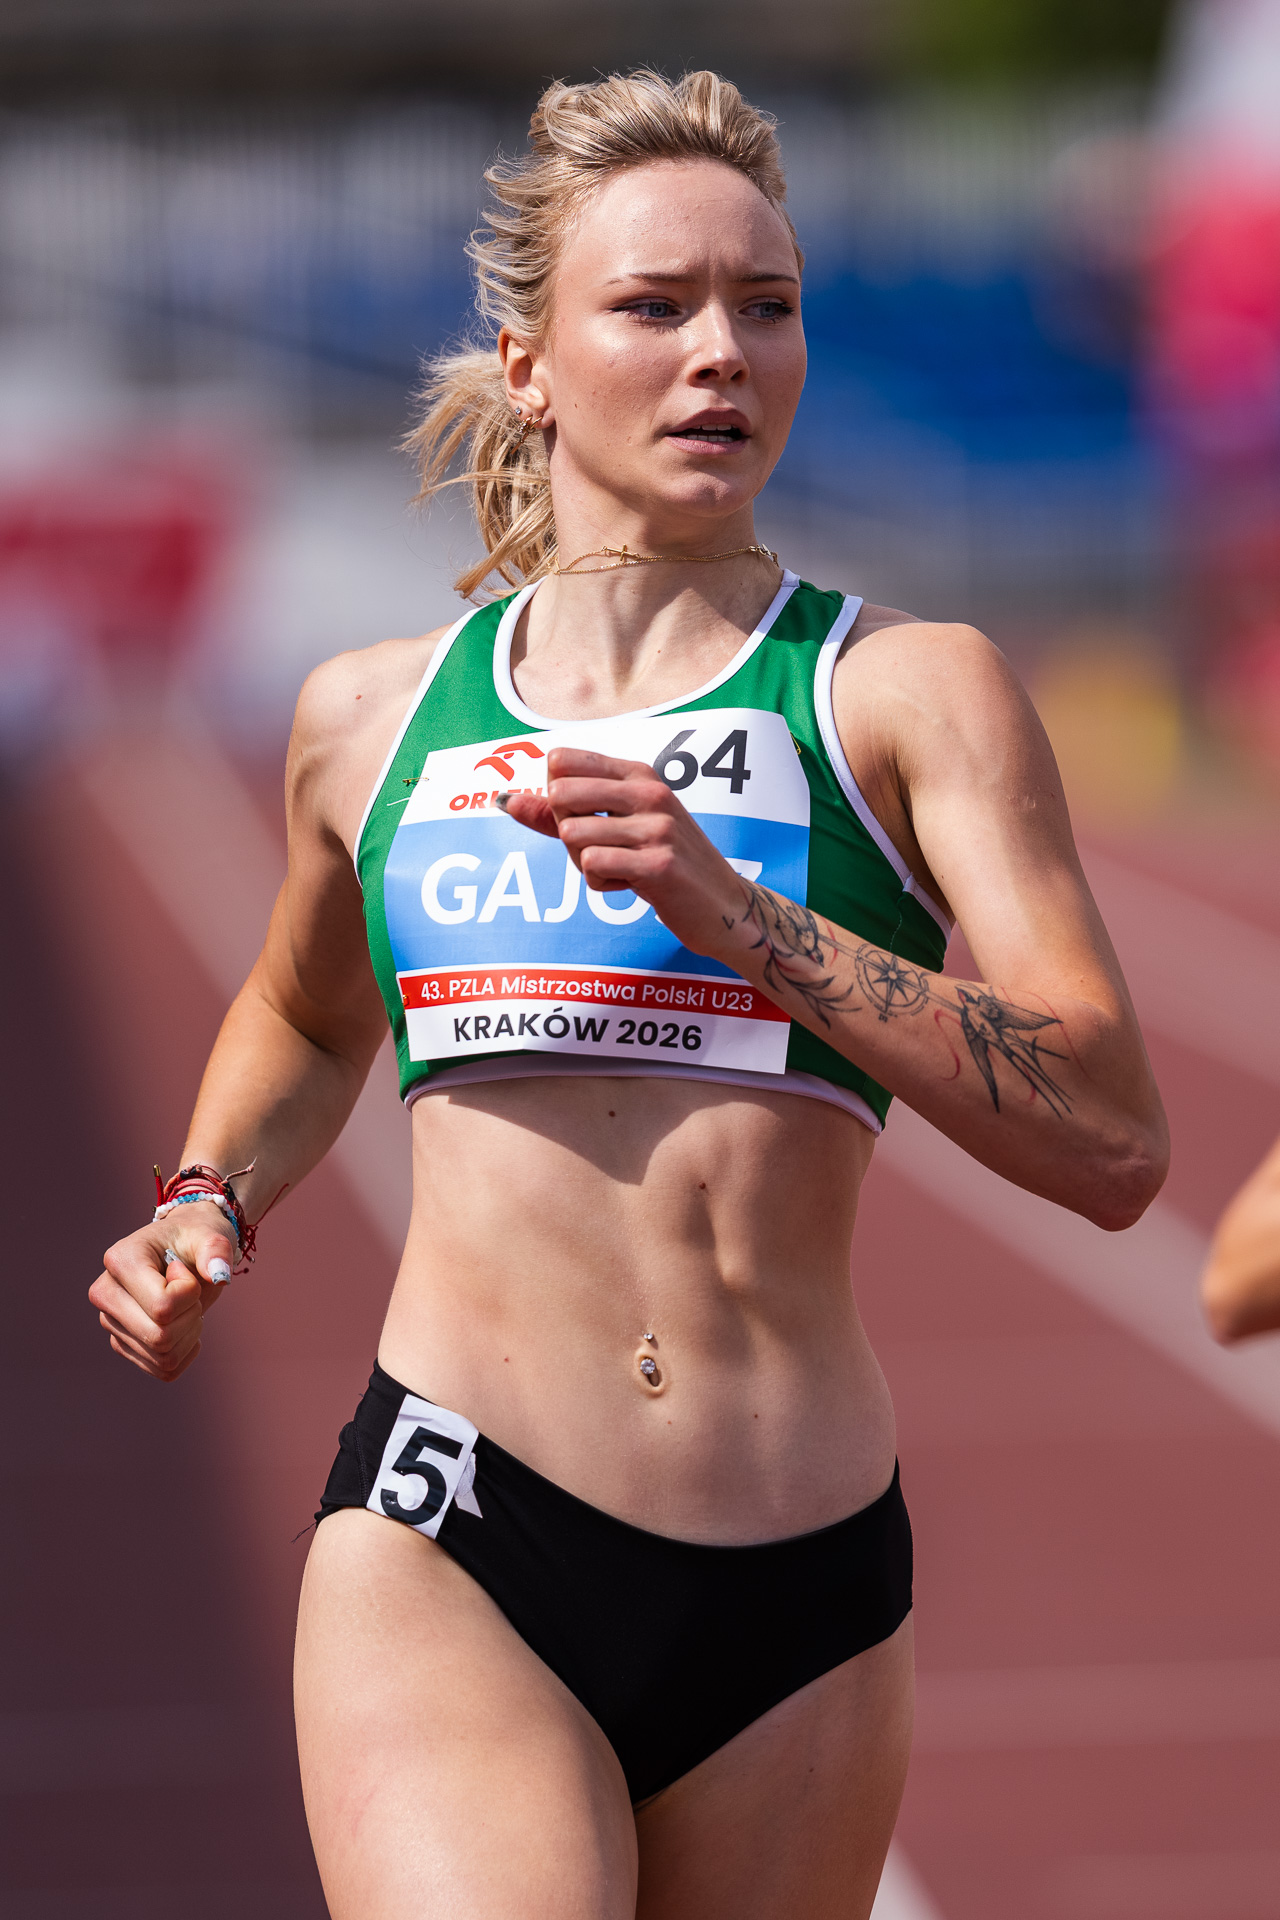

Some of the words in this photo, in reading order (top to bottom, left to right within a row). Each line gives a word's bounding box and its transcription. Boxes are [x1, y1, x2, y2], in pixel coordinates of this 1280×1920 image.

[653, 729, 752, 795] 64
[448, 787, 543, 811] ORL
[421, 980, 445, 1001] 43.
[449, 978, 495, 998] PZLA
[500, 975, 635, 1001] Mistrzostwa
[642, 984, 704, 1007] Polski
[712, 991, 754, 1012] U23
[453, 1006, 610, 1043] KRAKÓW
[615, 1018, 703, 1050] 2026
[380, 1425, 464, 1526] 5
